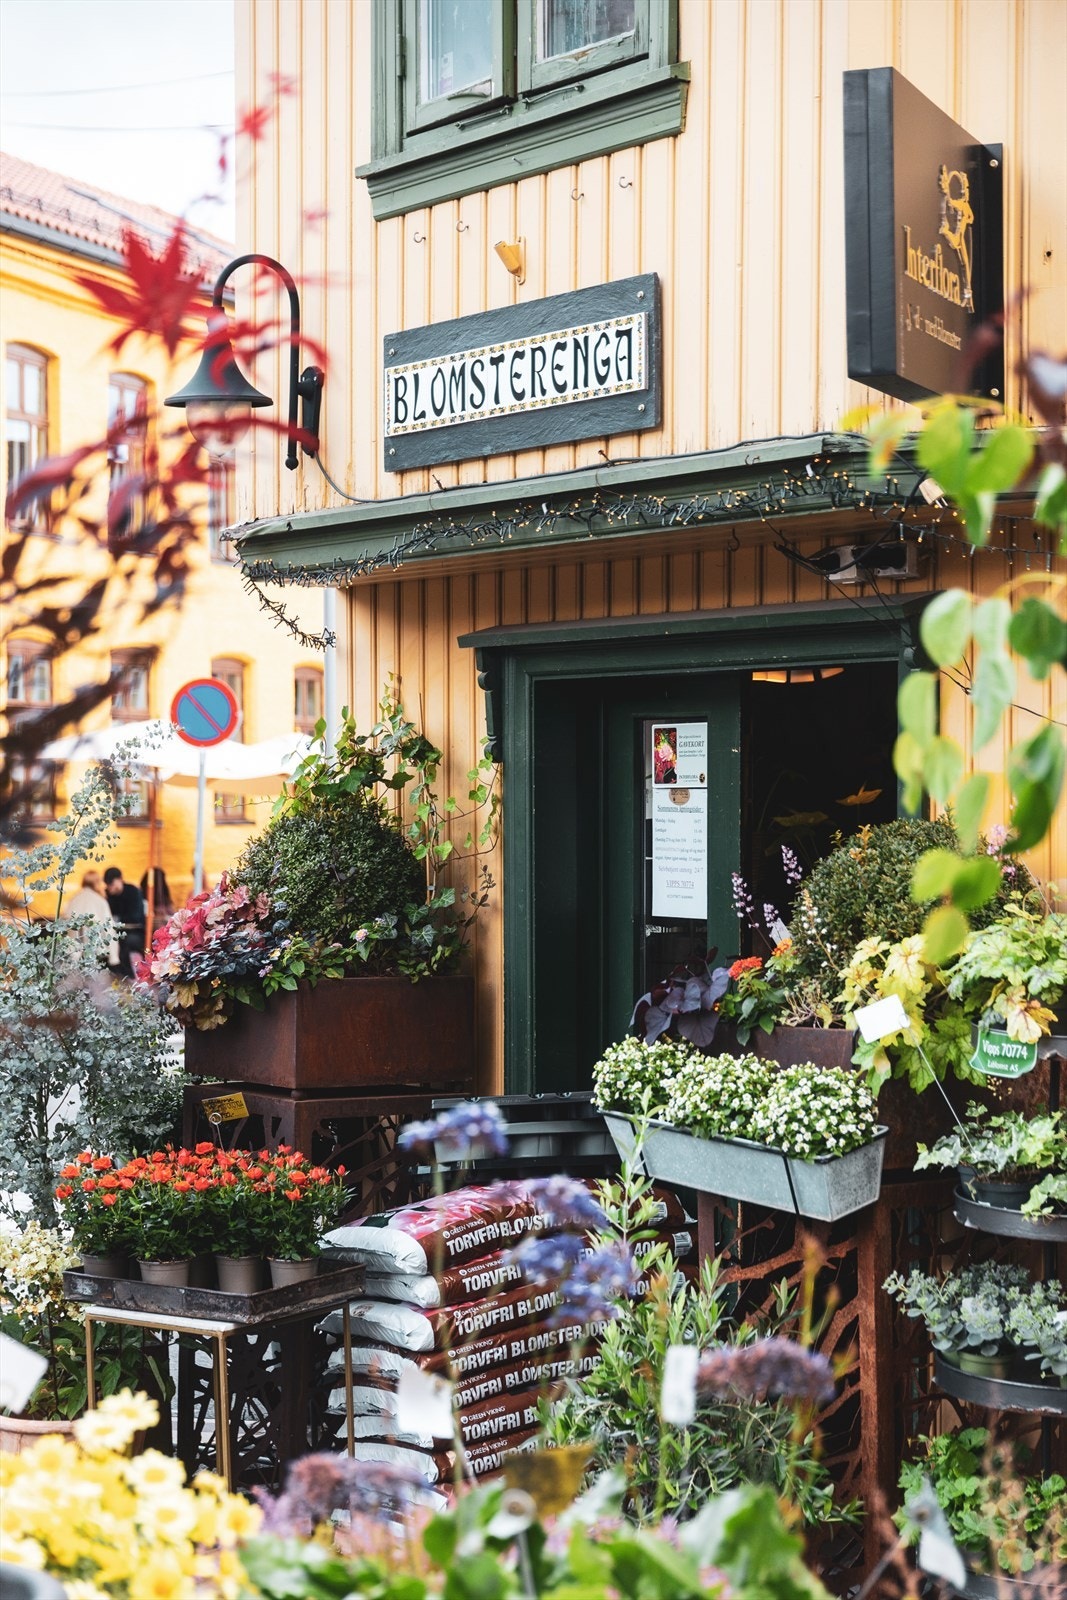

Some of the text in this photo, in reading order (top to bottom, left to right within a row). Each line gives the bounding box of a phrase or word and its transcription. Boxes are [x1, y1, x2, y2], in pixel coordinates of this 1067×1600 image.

[904, 224, 963, 307] Interflora
[393, 327, 633, 424] BLOMSTERENGA
[982, 1039, 1028, 1060] Vipps 70774
[446, 1222, 500, 1256] TORVFRI
[450, 1225, 466, 1236] GREEN
[462, 1264, 521, 1294] TORVFRI
[467, 1264, 485, 1273] GREEN
[455, 1304, 514, 1336] TORVFRI
[449, 1346, 507, 1373] TORVFRI
[455, 1338, 494, 1355] GREEN VIKING
[467, 1372, 487, 1383] VIKING
[452, 1376, 503, 1409] ORVFRI
[462, 1410, 521, 1442] TORVFRI
[468, 1405, 506, 1422] GREEN VIKING
[489, 1439, 508, 1450] VIKING
